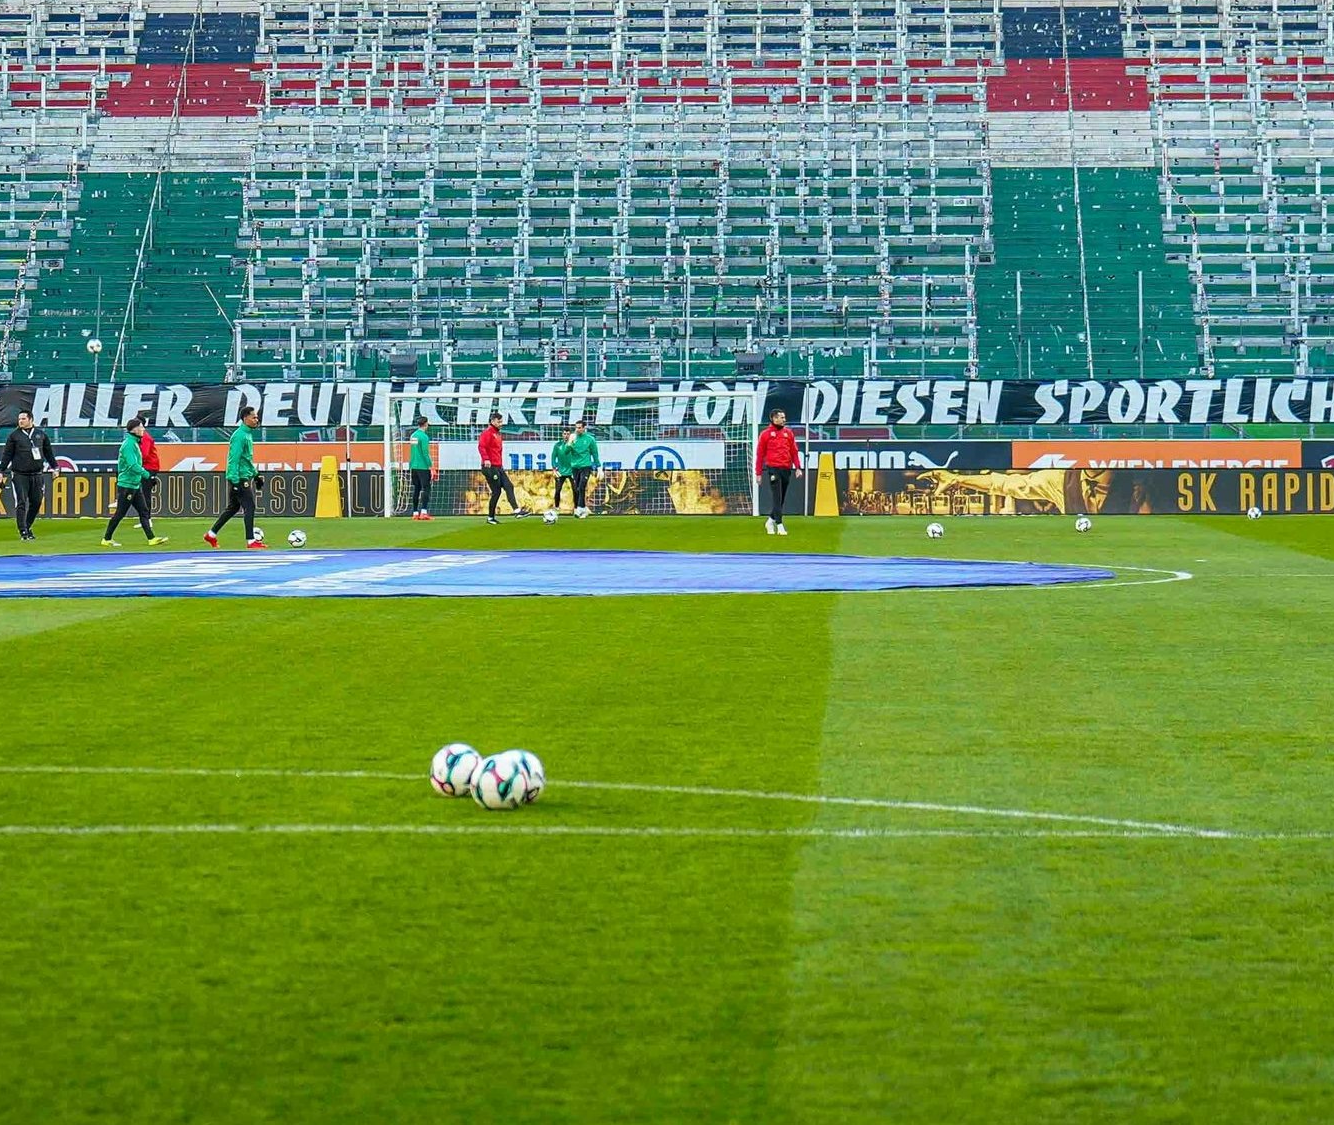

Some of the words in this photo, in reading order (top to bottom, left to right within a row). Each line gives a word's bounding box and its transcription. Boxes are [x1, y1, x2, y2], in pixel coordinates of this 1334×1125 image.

[31, 383, 192, 428] ALLER
[223, 381, 628, 427] DEUTLICHKEIT
[658, 380, 769, 425] VON
[800, 380, 1003, 425] DIESEN
[149, 474, 308, 515] BUSIESS
[1178, 472, 1217, 511] SK
